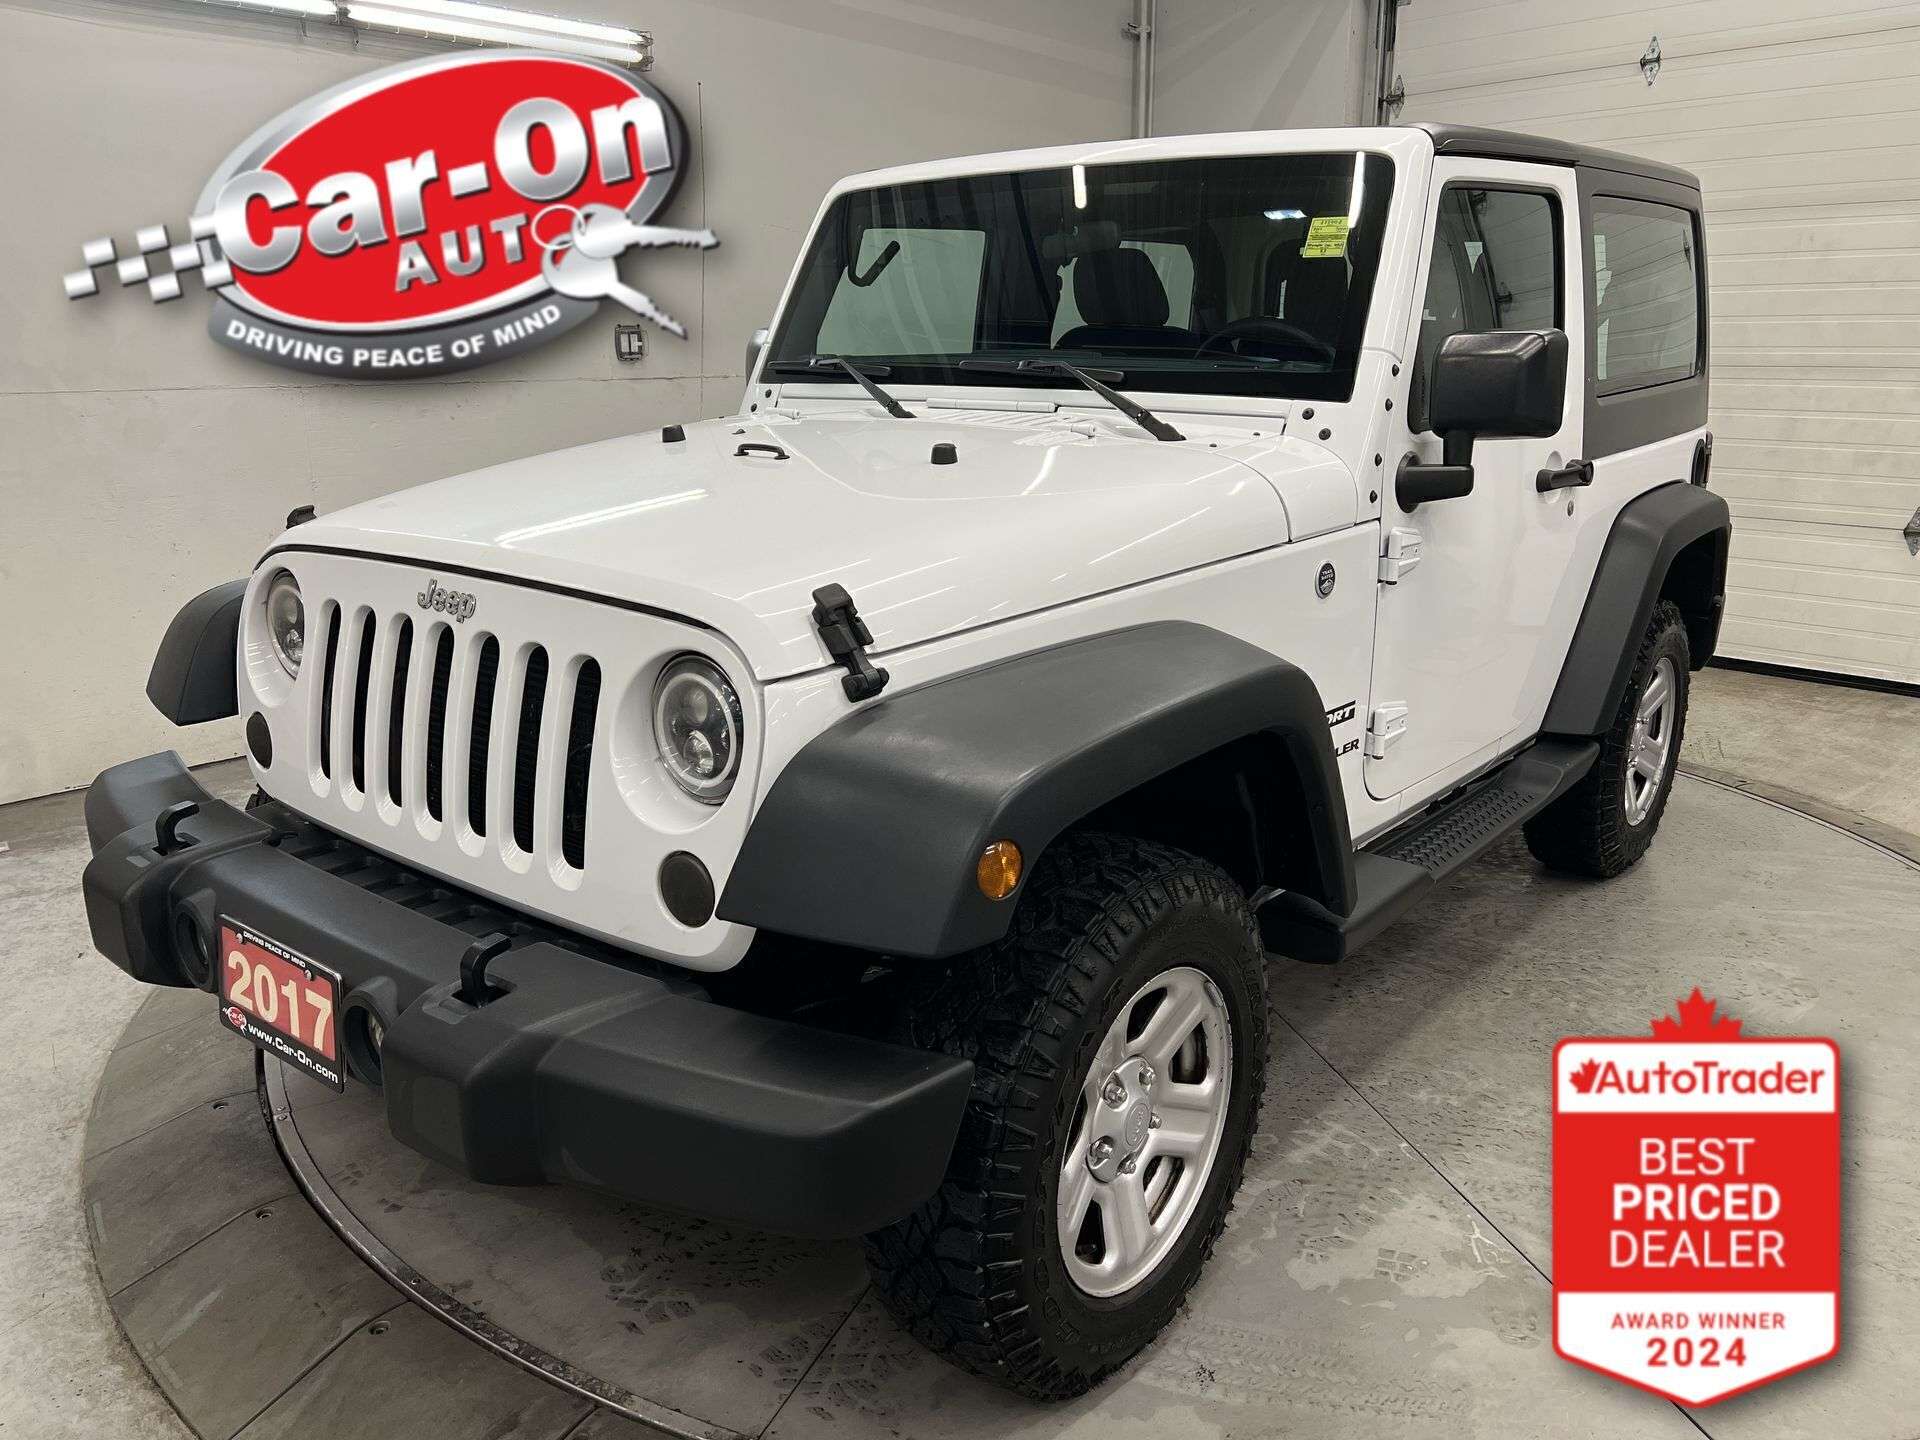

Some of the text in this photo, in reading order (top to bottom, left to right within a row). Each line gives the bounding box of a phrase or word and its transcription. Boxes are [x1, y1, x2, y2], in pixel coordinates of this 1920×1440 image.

[417, 578, 476, 624] Jeep
[283, 950, 291, 959] OF
[228, 950, 333, 1052] 2017
[248, 1023, 339, 1084] www.Car-On.com
